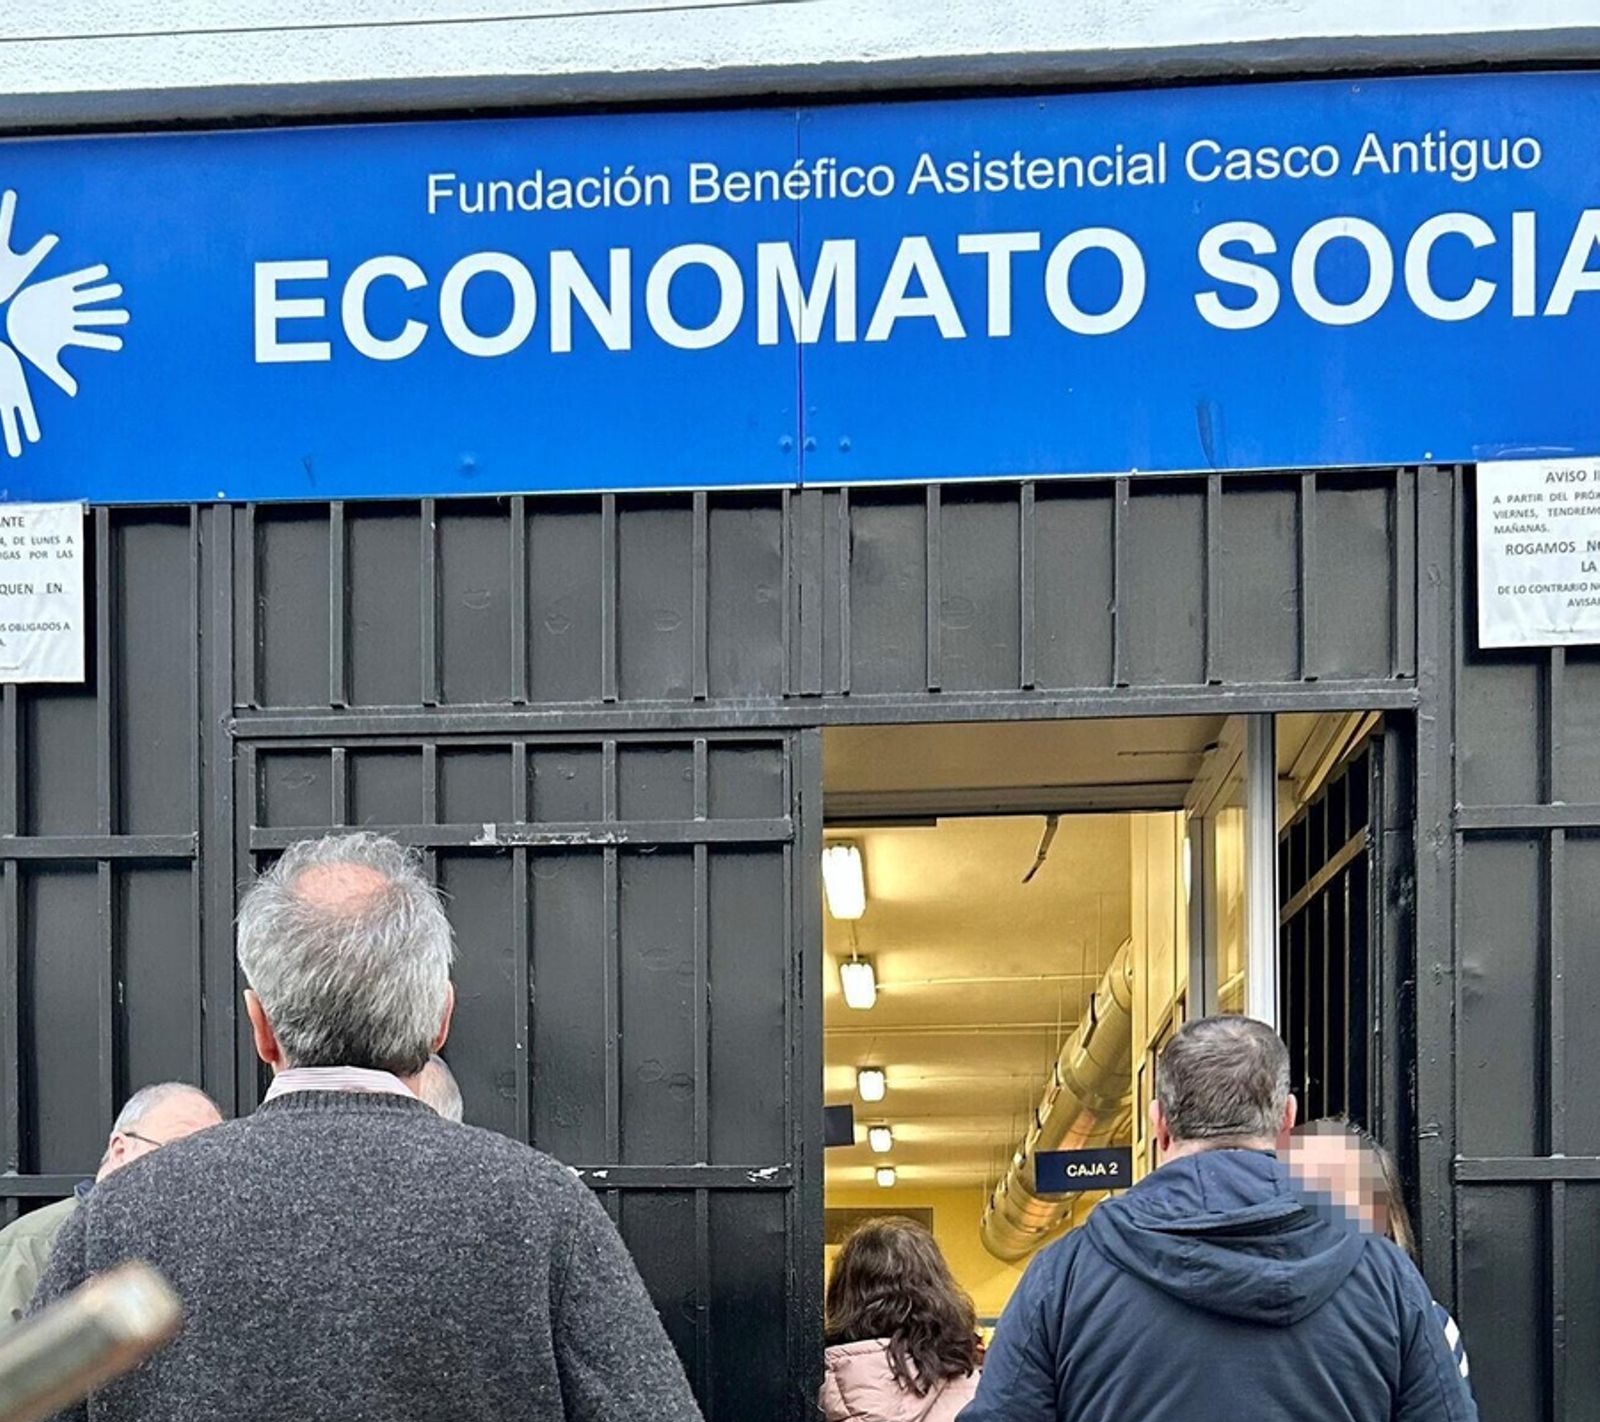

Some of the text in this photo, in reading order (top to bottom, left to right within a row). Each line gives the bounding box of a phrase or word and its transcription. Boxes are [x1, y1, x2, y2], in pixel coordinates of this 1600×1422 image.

[427, 130, 1541, 214] Fundación Benéfico Asistencial Casco Antiguo
[255, 227, 1146, 363] ECONOMATO
[1545, 469, 1587, 484] AVISO
[1492, 495, 1501, 504] A
[1507, 493, 1543, 503] PARTIR
[1549, 491, 1568, 502] DEL
[1493, 508, 1539, 520] VIERNES,
[1494, 523, 1550, 534] MAÑANAS.
[13, 536, 25, 546] DE
[31, 535, 61, 545] LUNES
[66, 535, 74, 544] A
[29, 550, 48, 560] POR
[56, 549, 73, 559] LAS
[1504, 541, 1576, 556] ROGAMOS
[1580, 560, 1597, 573] LA
[46, 582, 63, 594] EN
[1497, 585, 1510, 595] DE
[1513, 584, 1527, 594] LO
[1528, 582, 1588, 594] CONTRARIO
[8, 622, 61, 632] OBLIGADOS
[63, 621, 71, 631] A
[1066, 1161, 1119, 1177] CAJA 2
